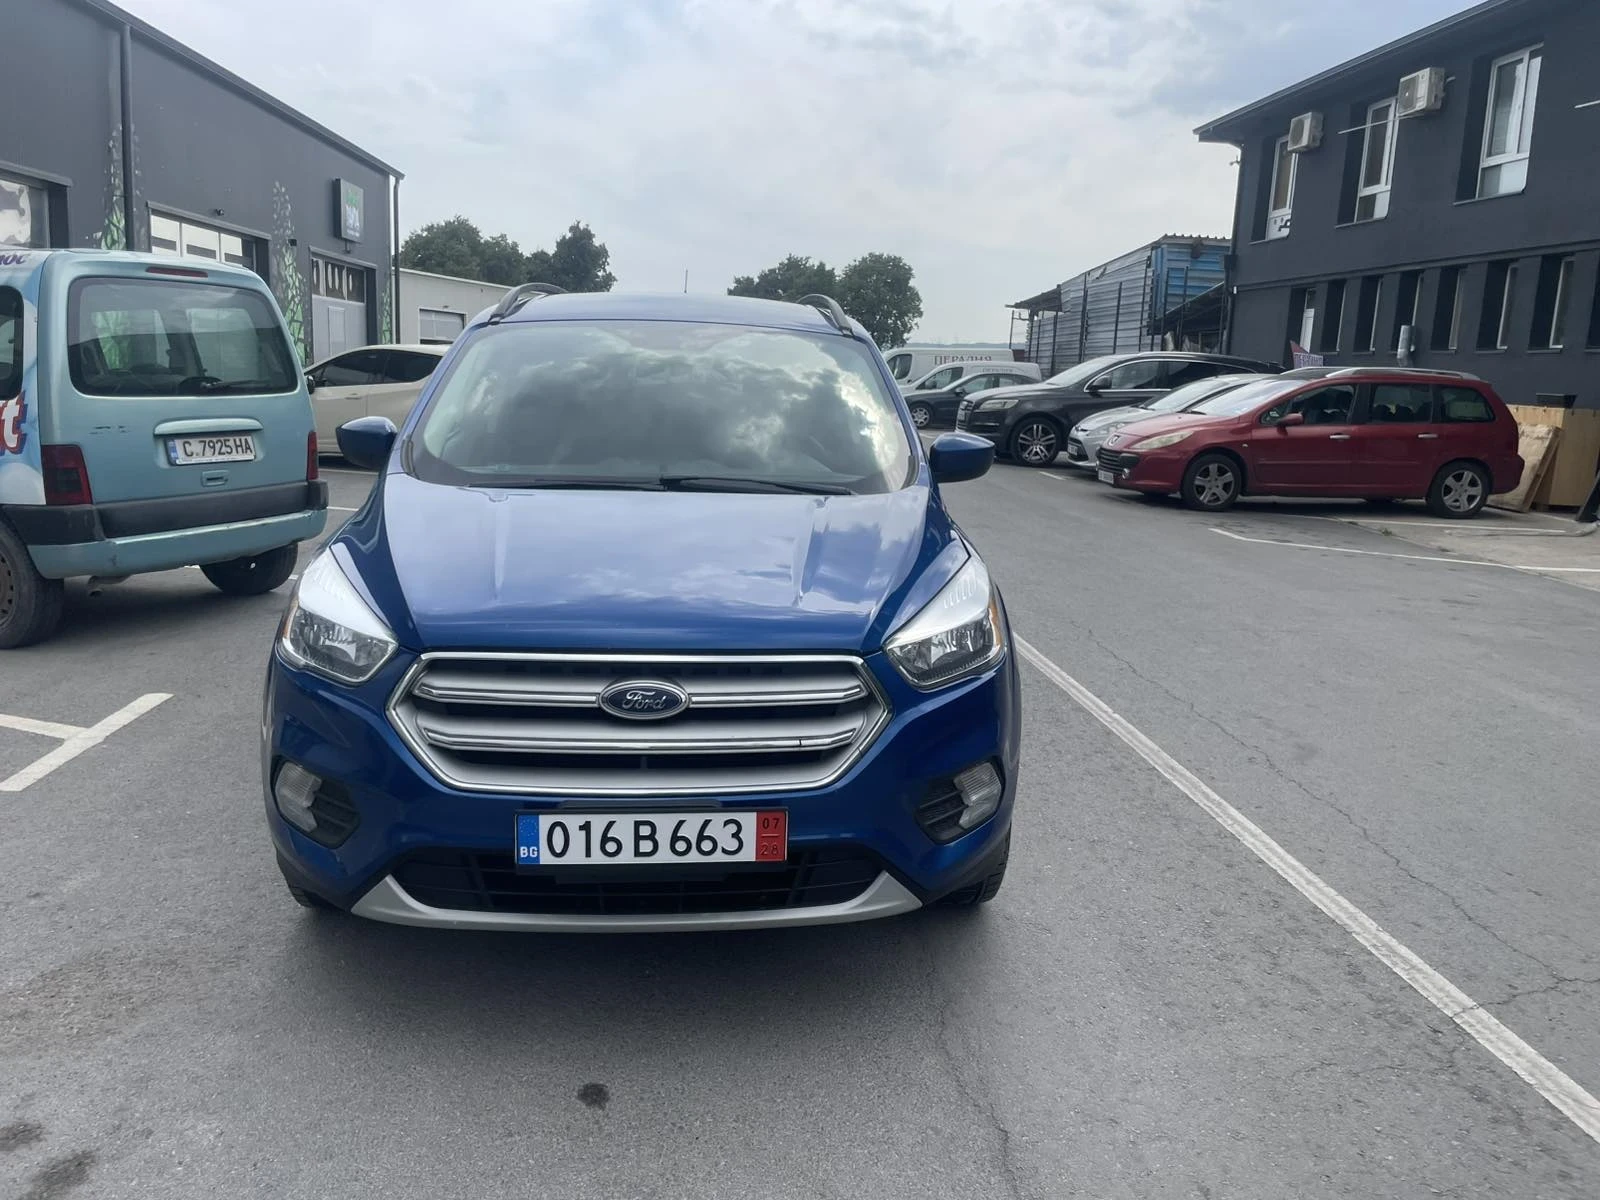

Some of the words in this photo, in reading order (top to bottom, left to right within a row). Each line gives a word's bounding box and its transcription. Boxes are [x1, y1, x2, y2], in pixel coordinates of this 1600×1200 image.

[622, 690, 666, 710] Ford
[762, 817, 780, 830] 07
[520, 846, 538, 858] BG
[760, 842, 779, 856] 28
